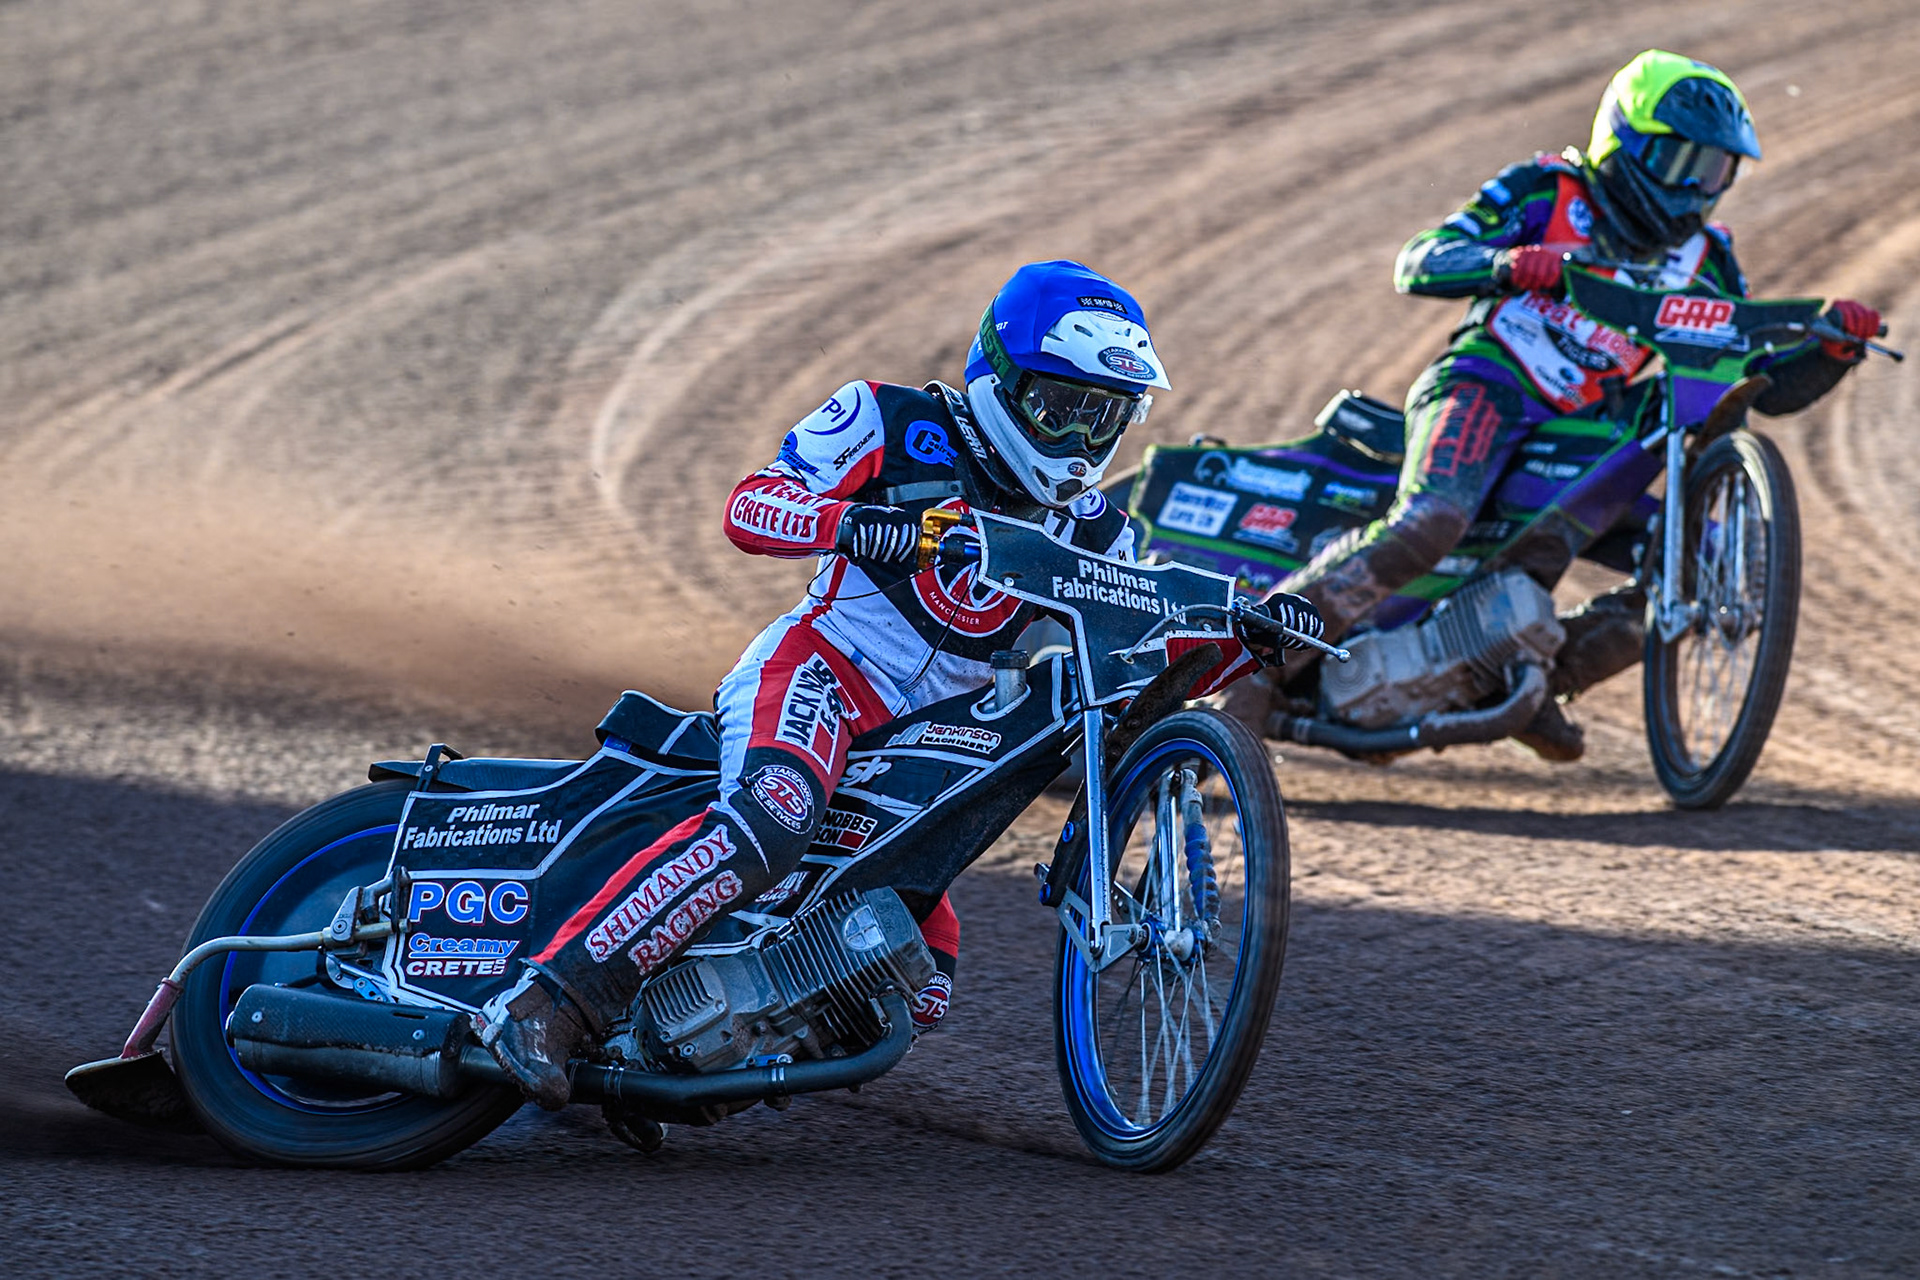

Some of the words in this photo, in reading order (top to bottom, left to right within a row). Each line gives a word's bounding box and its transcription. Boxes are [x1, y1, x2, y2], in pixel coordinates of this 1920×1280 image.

[1110, 357, 1144, 370] STS
[1068, 464, 1086, 475] STS
[734, 496, 782, 532] CRETE
[782, 511, 815, 537] LTD
[1078, 559, 1157, 593] Philmar
[1052, 576, 1160, 614] Fabrications
[1163, 597, 1187, 625] Ltd
[783, 692, 821, 746] JACK
[924, 736, 993, 751] MACHINERY
[763, 777, 803, 814] STS
[765, 768, 812, 805] STAKEFORD
[447, 803, 540, 823] Philmar
[764, 800, 801, 829] SERVICES
[822, 810, 876, 833] NOBBS
[403, 823, 523, 850] Fabrications
[525, 820, 562, 844] Ltd
[408, 880, 530, 924] PGC
[589, 830, 731, 957] SHIMANDY
[634, 875, 738, 970] RACING
[408, 932, 520, 957] Creamy
[406, 960, 493, 976] CRETE
[913, 993, 948, 1018] STS
